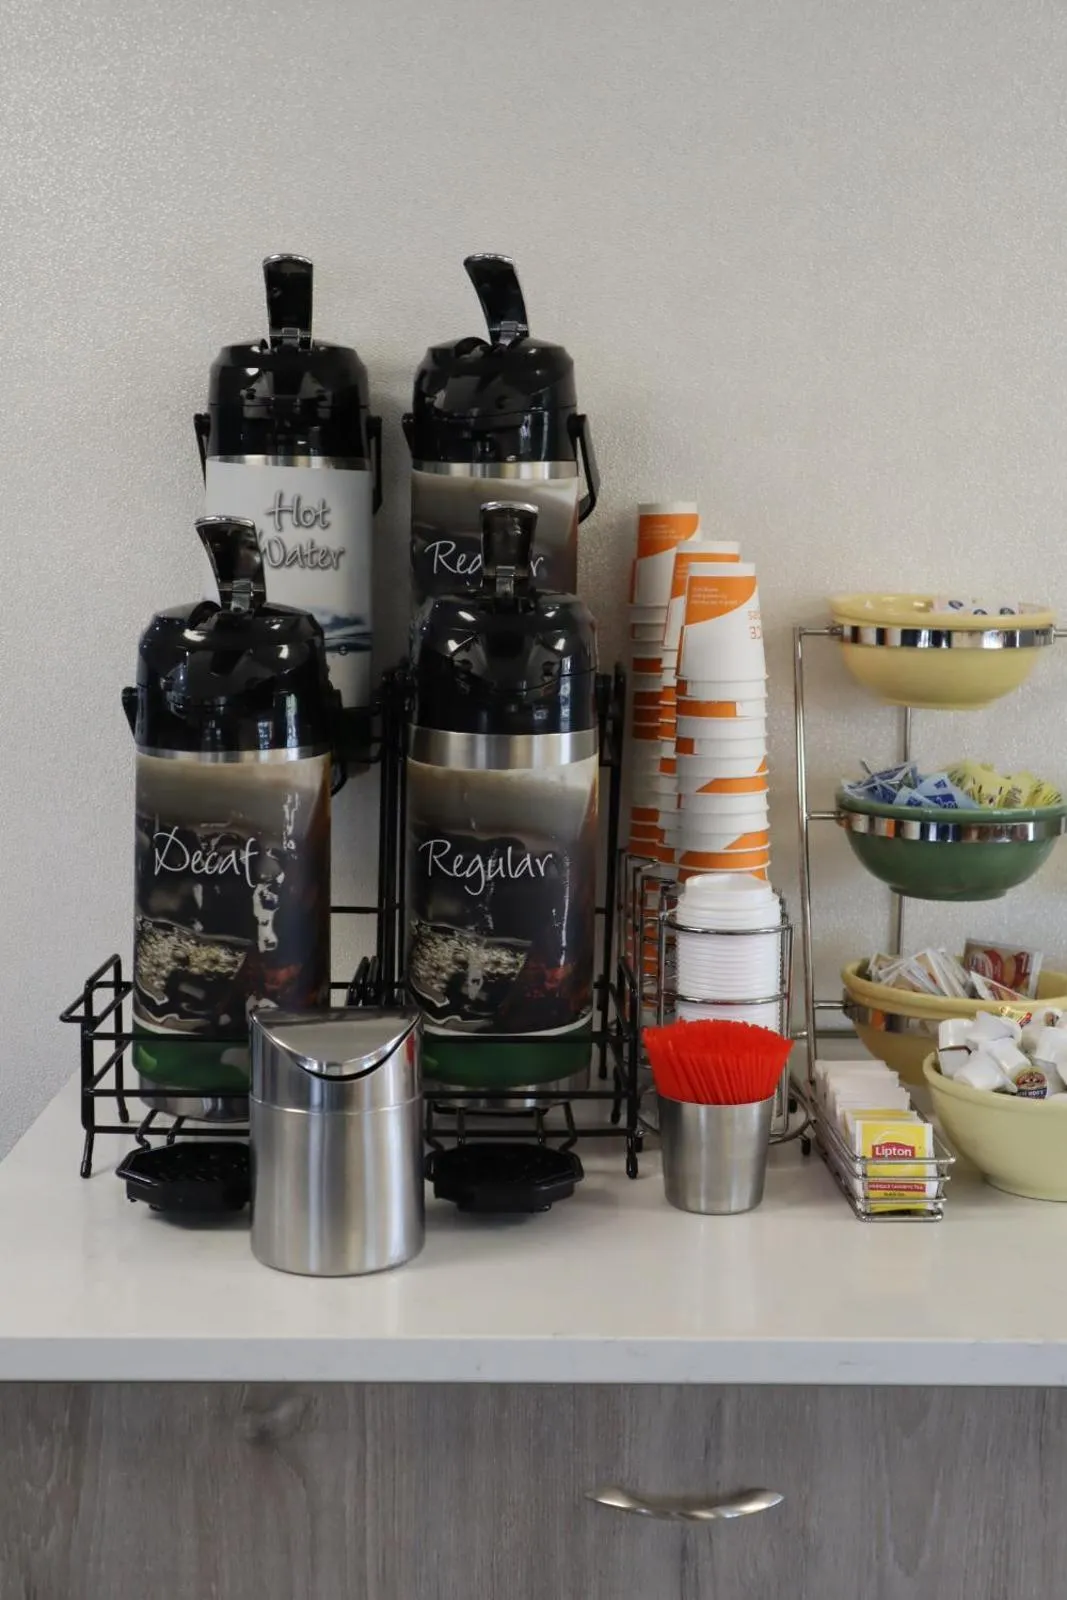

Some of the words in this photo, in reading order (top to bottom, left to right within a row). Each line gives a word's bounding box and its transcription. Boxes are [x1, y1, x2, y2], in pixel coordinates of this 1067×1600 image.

[265, 490, 331, 531] Hot
[153, 826, 258, 888] Decaf
[419, 839, 552, 897] Regular
[875, 1147, 912, 1159] Lipton
